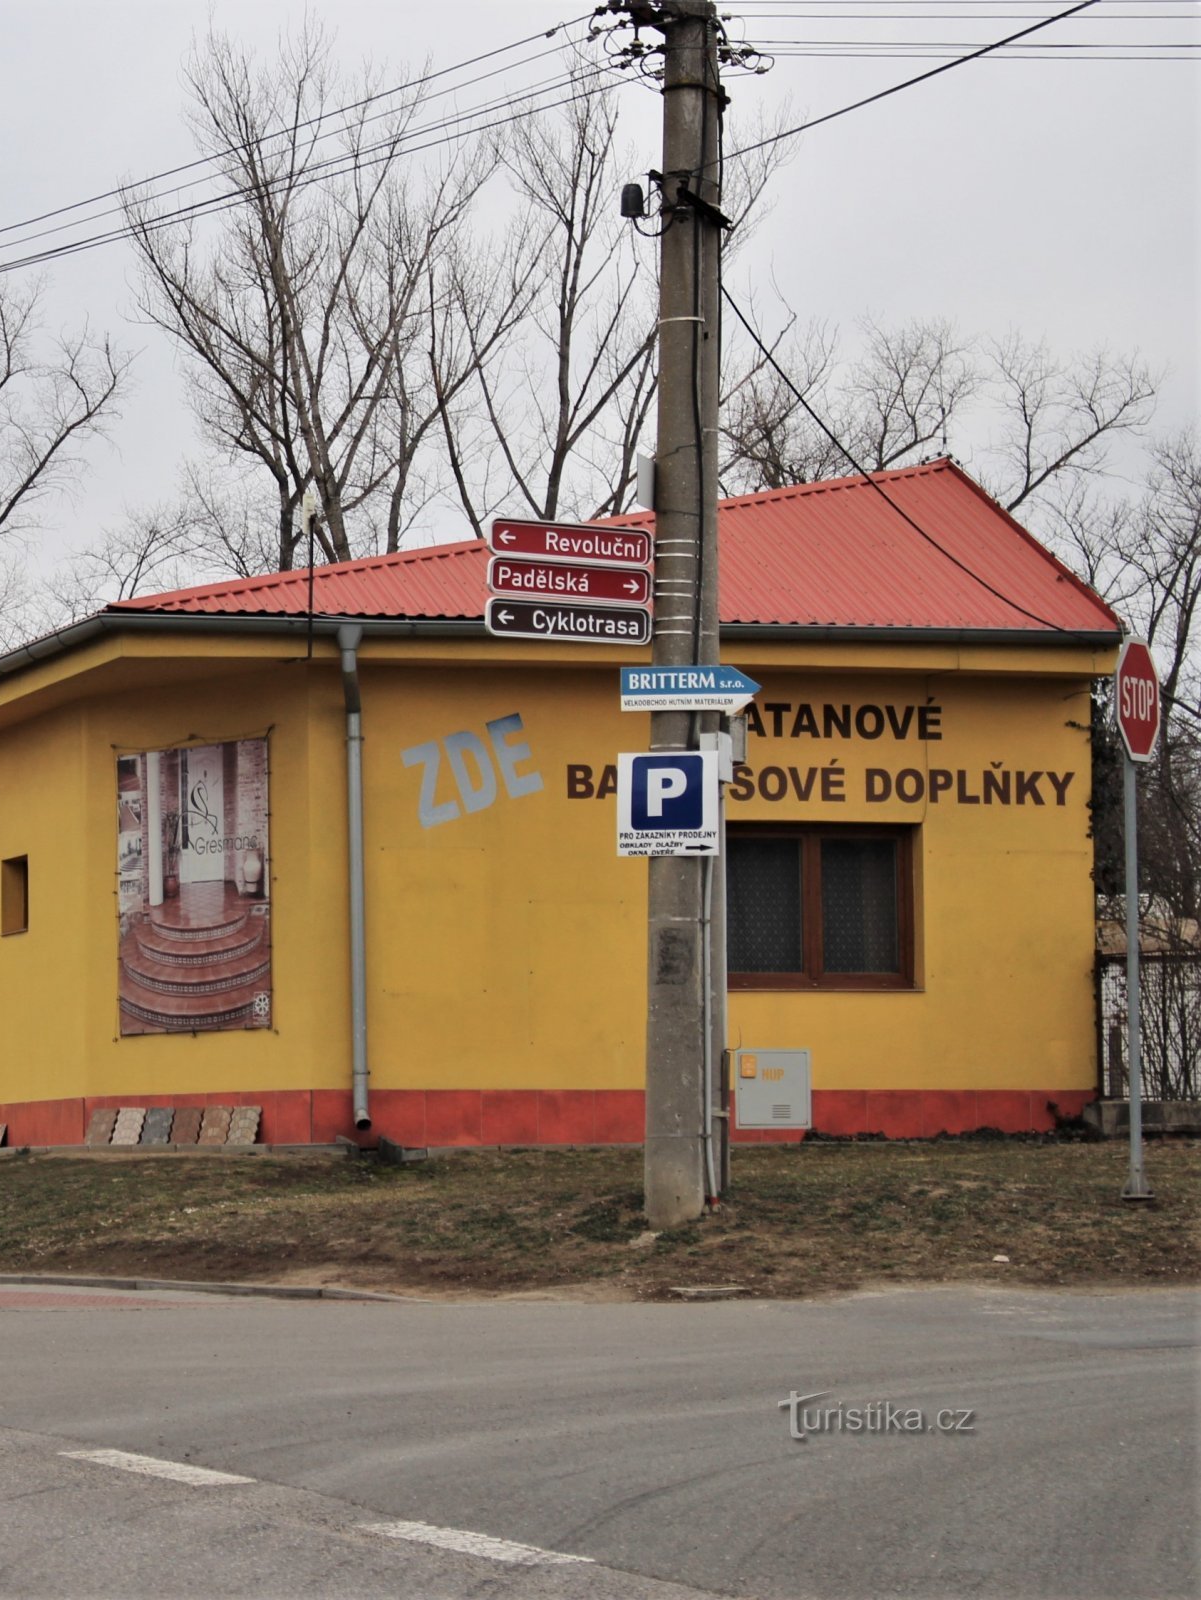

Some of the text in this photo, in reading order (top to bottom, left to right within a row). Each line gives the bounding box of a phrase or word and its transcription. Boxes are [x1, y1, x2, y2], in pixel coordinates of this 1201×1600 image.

[545, 531, 643, 558] Revoluční
[498, 566, 589, 592] Padělská
[532, 610, 639, 636] Cyklotrasa
[628, 672, 745, 690] BRITTERM s.r.o.
[1123, 675, 1154, 722] STOP
[743, 697, 943, 740] ATANOVÉ
[401, 712, 545, 830] ZDE
[865, 761, 1075, 806] DOPLŇKY
[647, 768, 687, 817] P
[619, 830, 717, 840] PRO ZÁKAZNÍKY PRODEJNY
[655, 840, 684, 848] DLAŽBY
